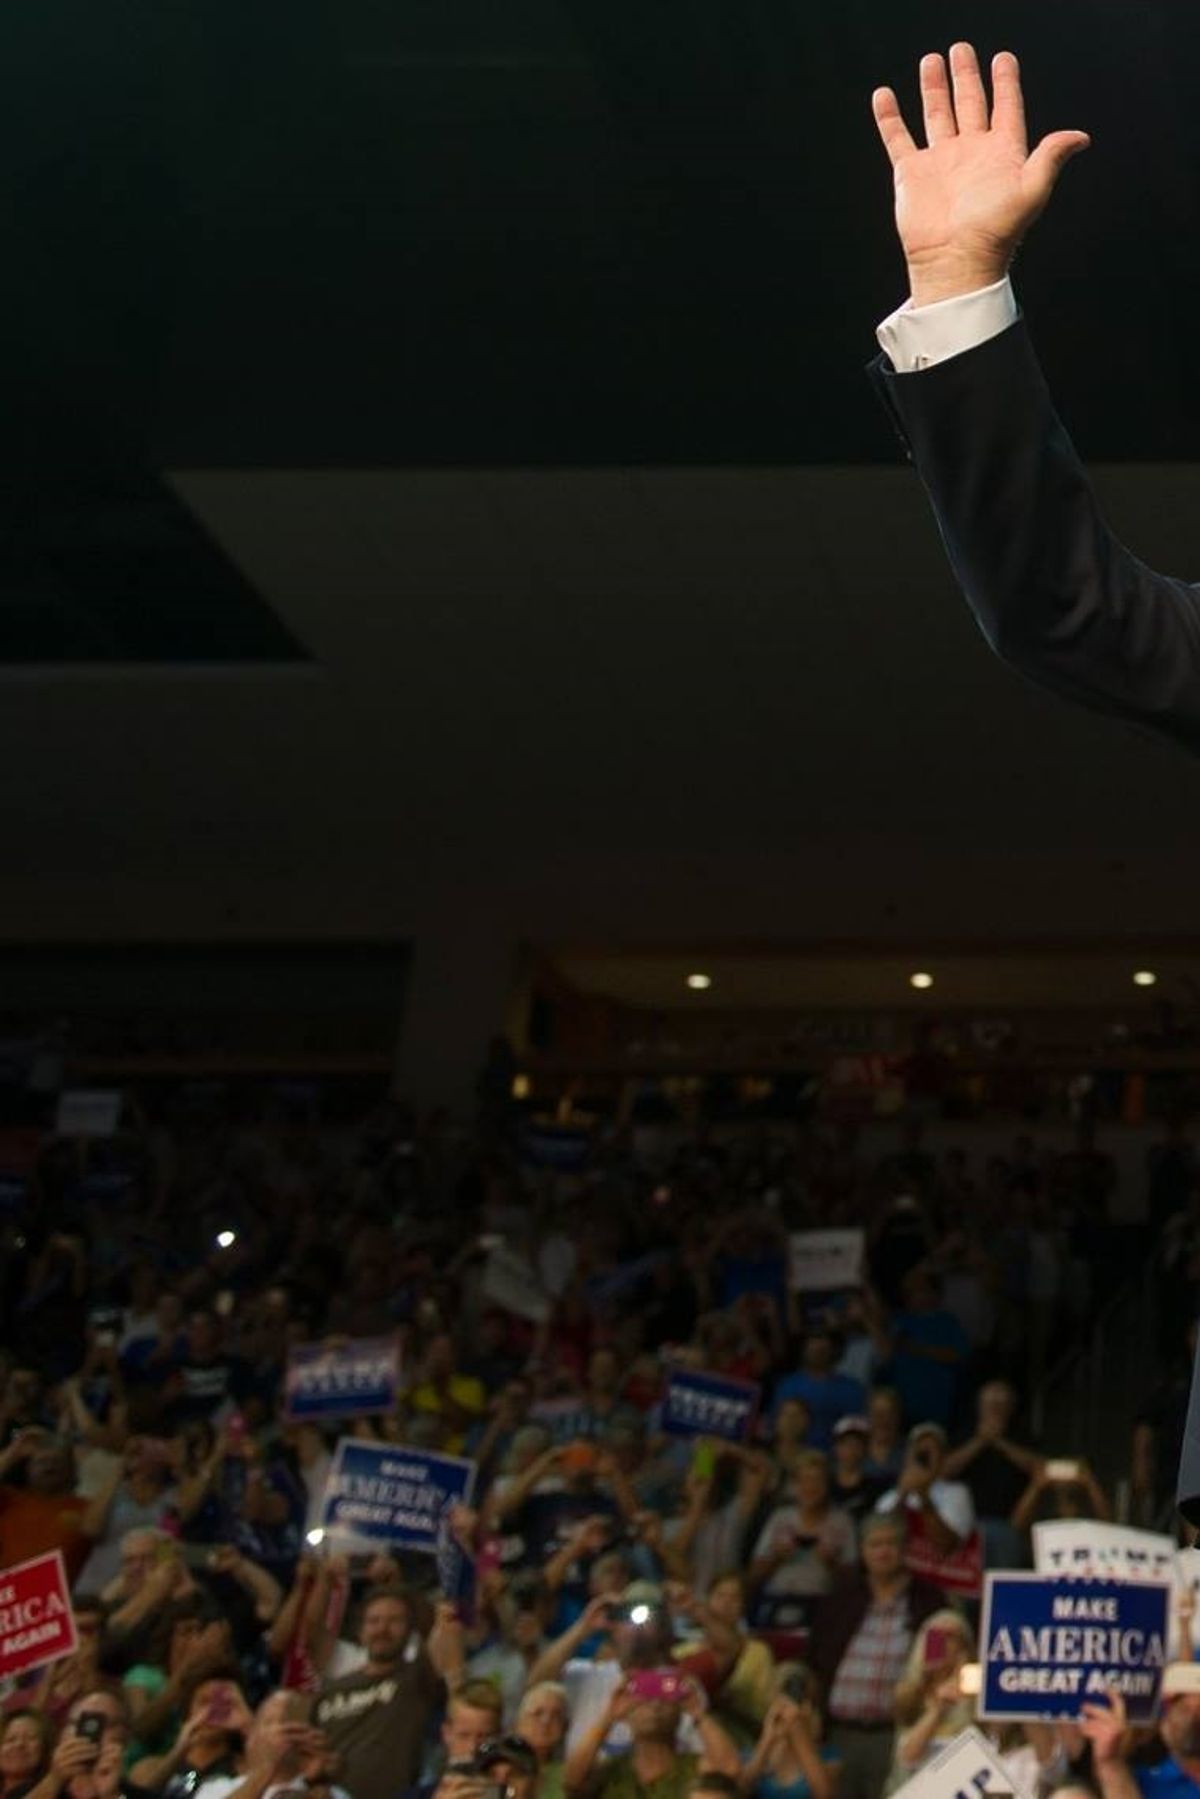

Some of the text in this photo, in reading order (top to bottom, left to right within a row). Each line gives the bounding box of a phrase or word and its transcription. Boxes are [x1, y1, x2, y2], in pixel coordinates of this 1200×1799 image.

[1052, 1595, 1119, 1622] MAKE
[989, 1625, 1166, 1668] AMERICA
[998, 1667, 1157, 1697] GREAT AGAIN
